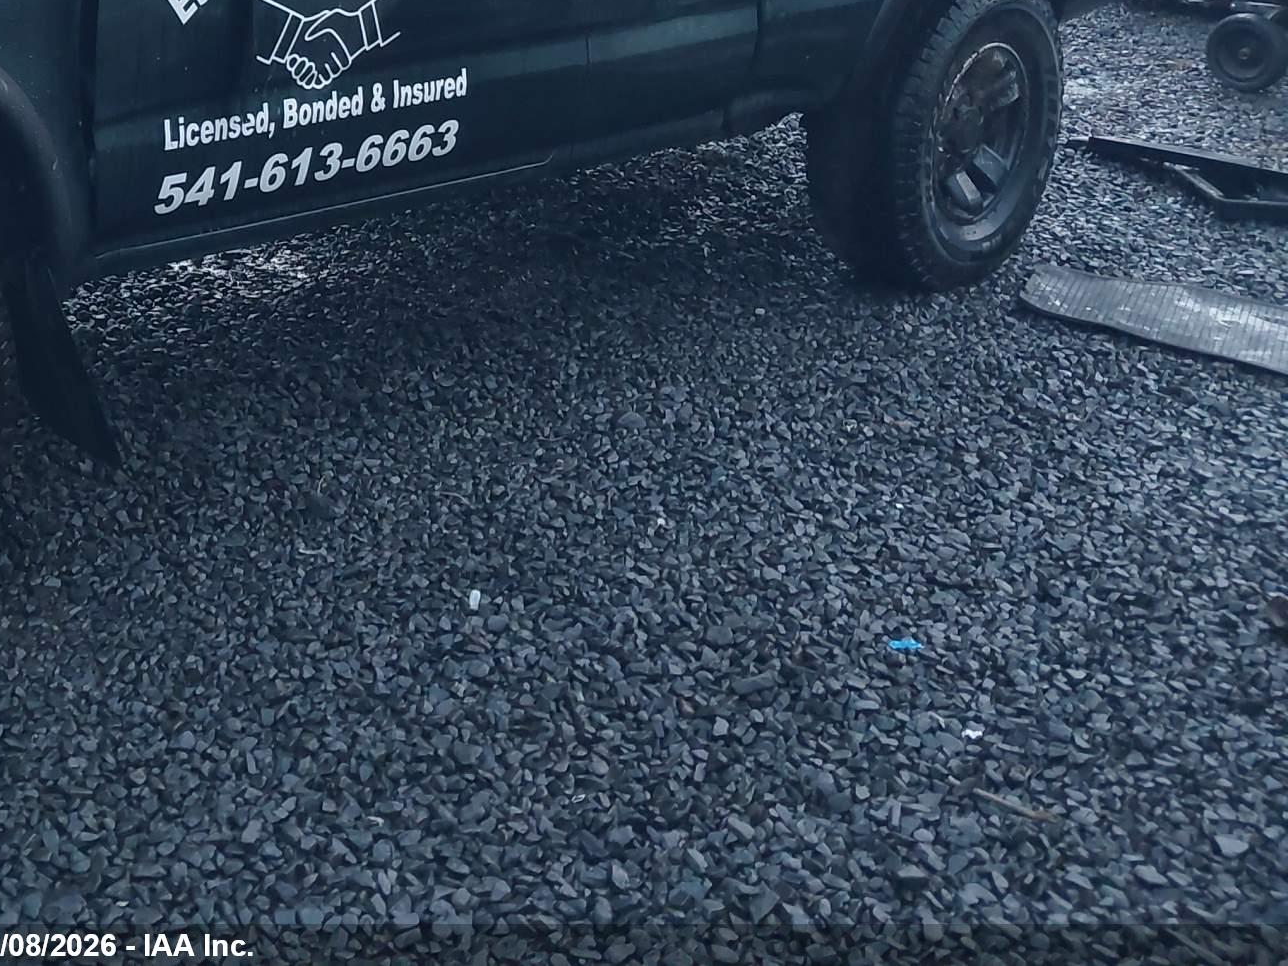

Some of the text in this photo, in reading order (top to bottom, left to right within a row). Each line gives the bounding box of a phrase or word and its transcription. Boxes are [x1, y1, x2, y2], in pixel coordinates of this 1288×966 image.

[164, 67, 468, 152] Licensed, Bonded & Insured
[154, 119, 460, 215] 541-613-6663
